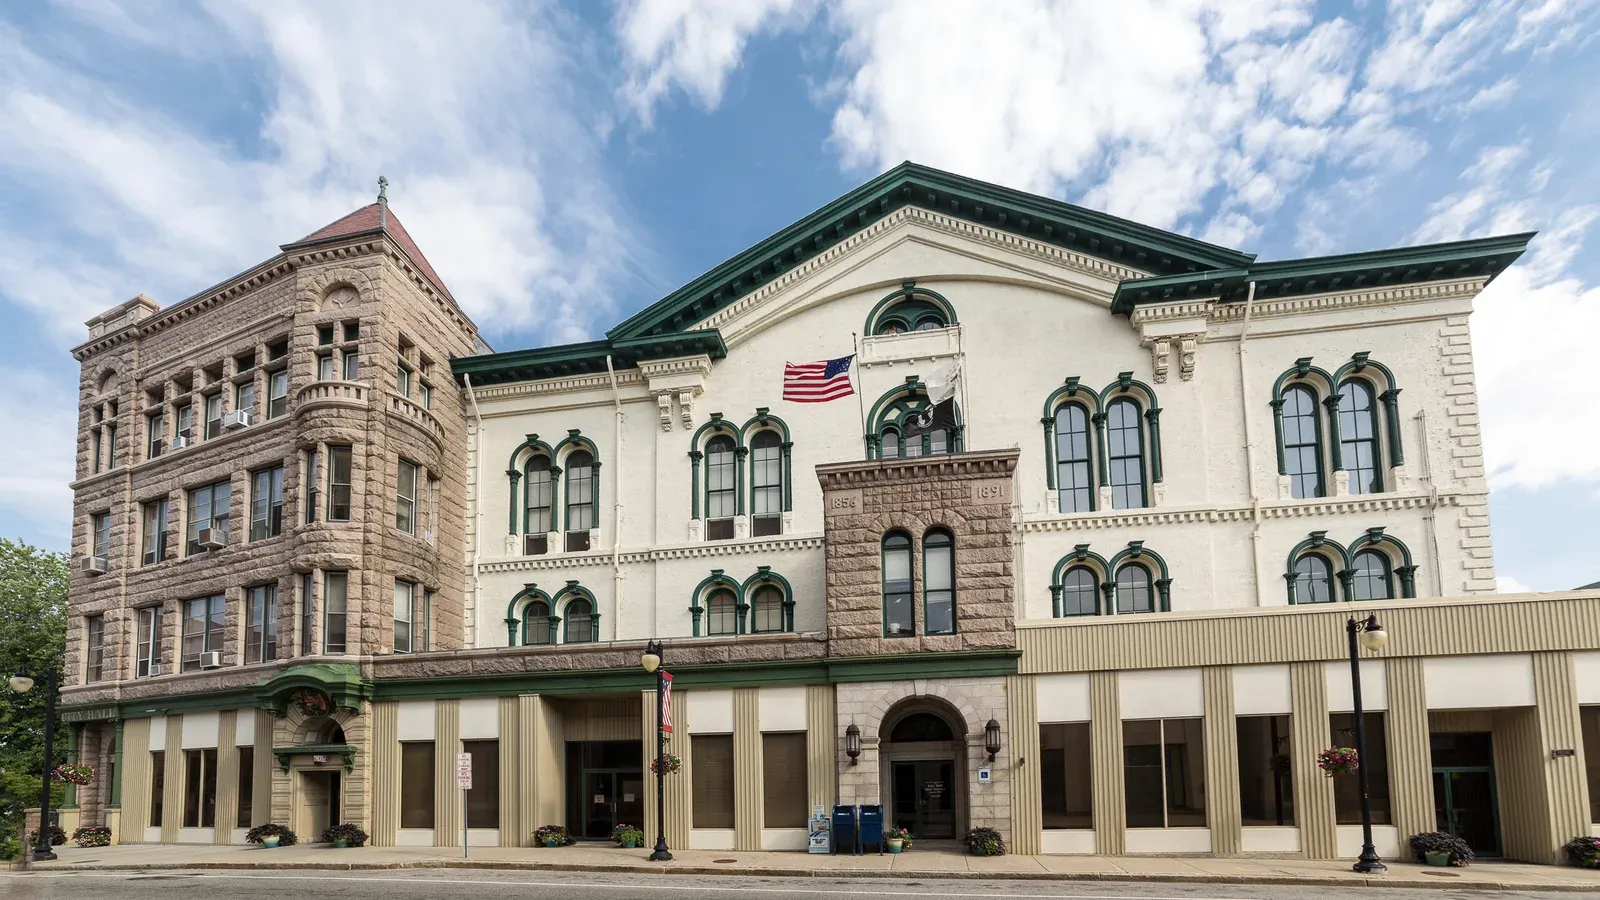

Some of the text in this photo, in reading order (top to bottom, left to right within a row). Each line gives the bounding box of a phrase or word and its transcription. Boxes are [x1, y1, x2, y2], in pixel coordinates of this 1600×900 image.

[977, 484, 1004, 498] 1891
[831, 496, 857, 509] 1856
[62, 708, 116, 721] CITY HALL
